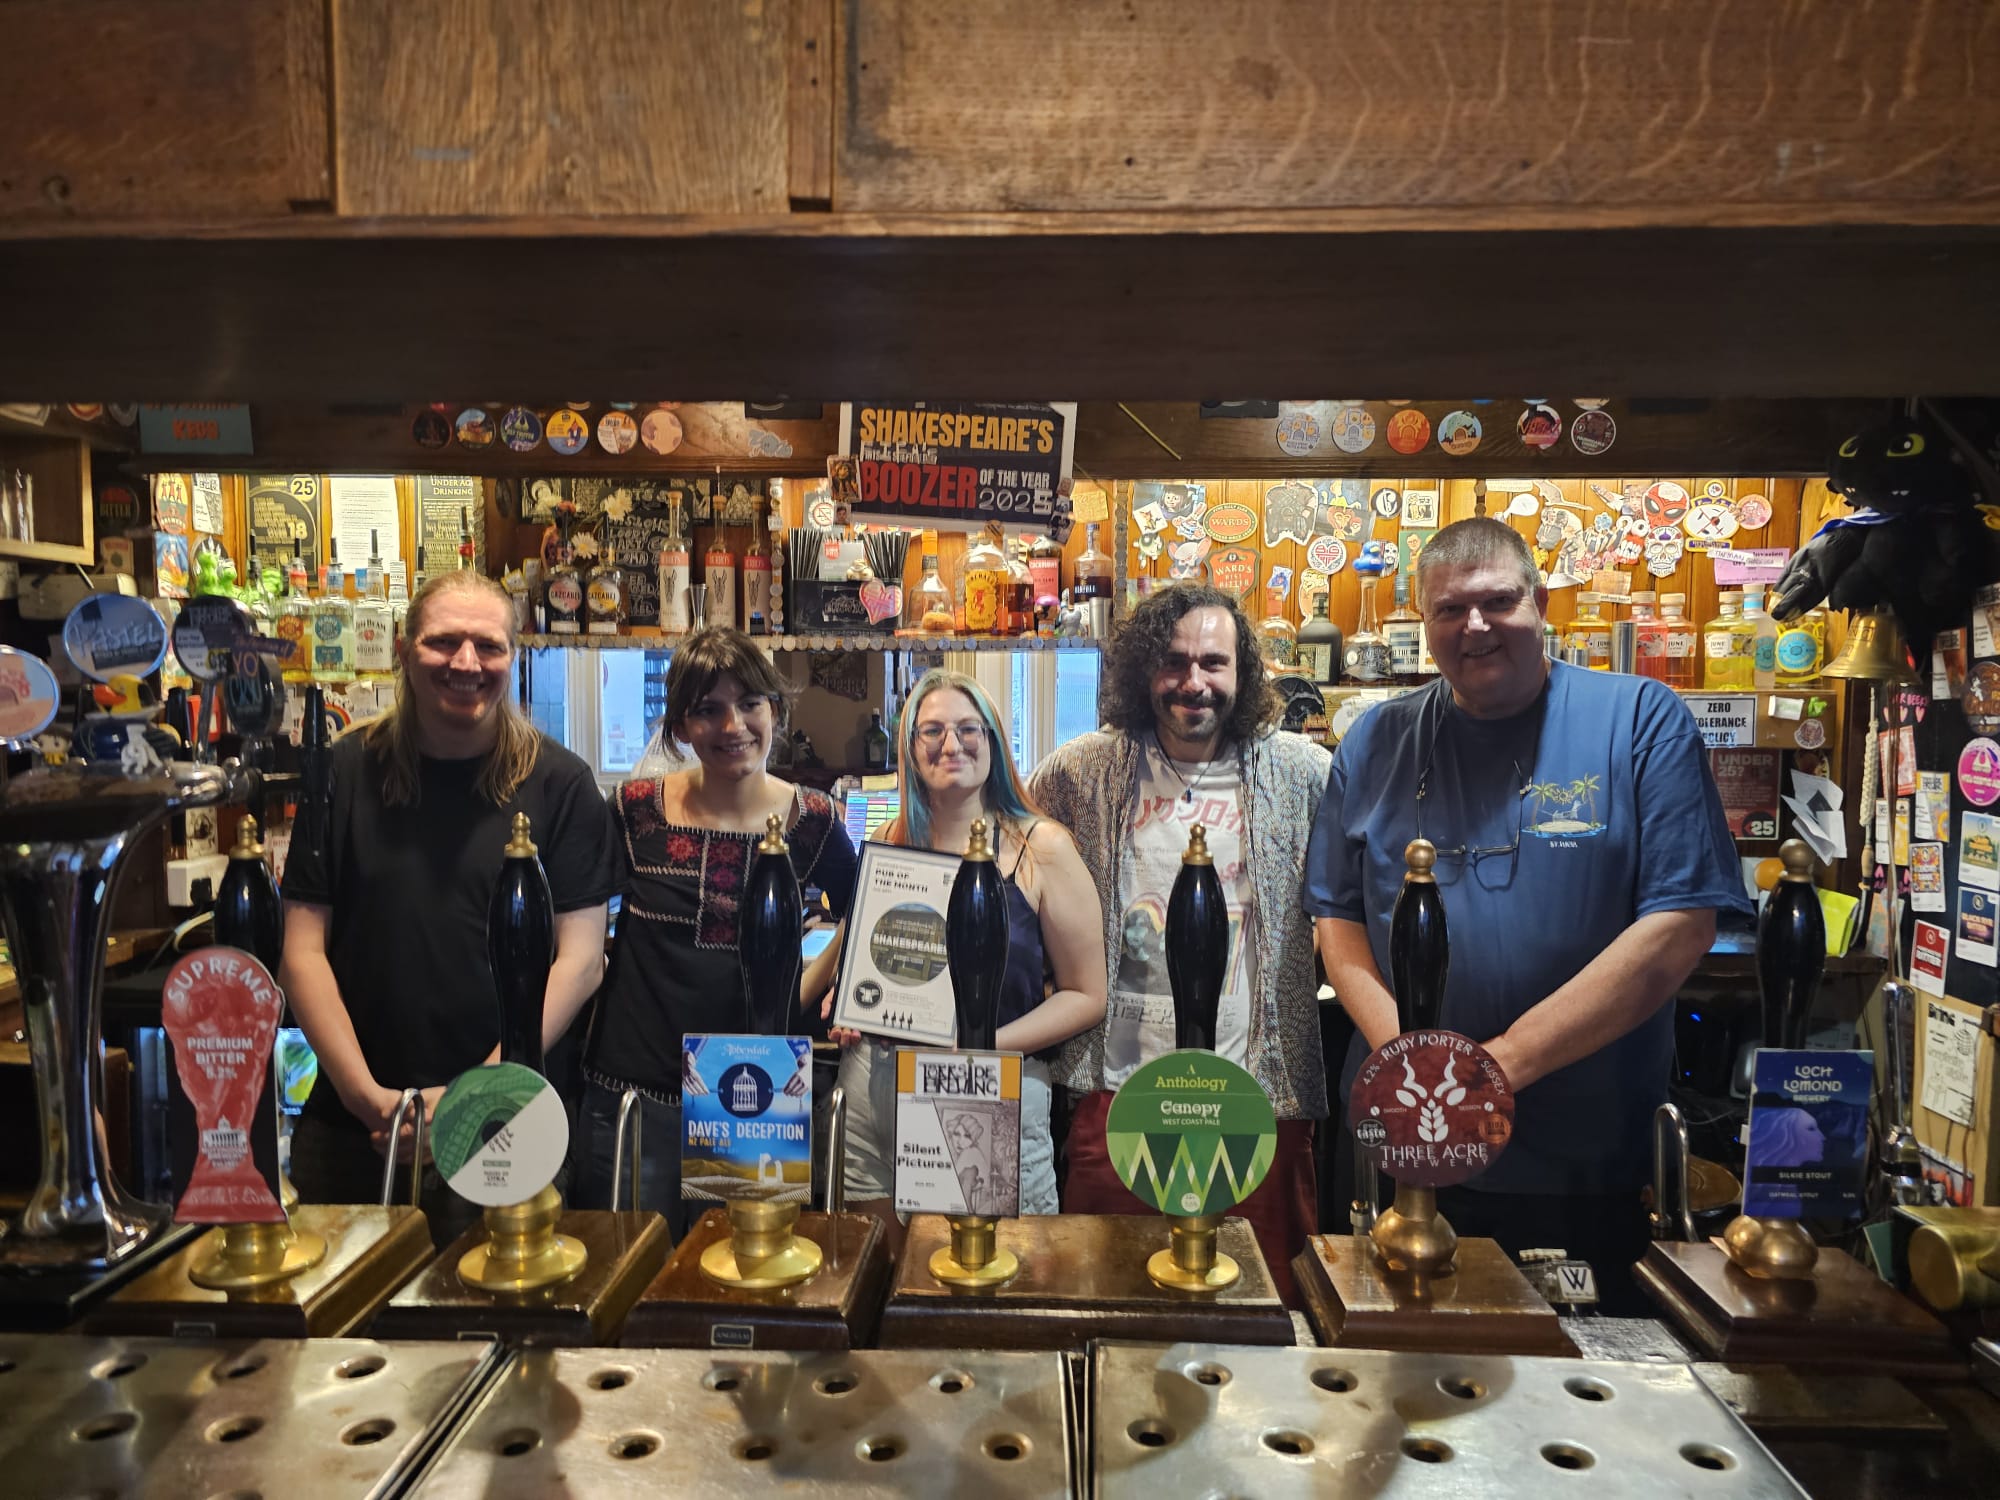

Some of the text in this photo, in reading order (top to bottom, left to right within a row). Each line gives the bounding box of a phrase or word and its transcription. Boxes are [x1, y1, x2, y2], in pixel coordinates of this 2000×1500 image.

[860, 408, 1054, 453] SHAKESPEARE'S
[293, 480, 314, 496] 25
[860, 461, 1050, 509] BOOZER OF THE YEAR
[1211, 518, 1249, 526] WARDS
[1215, 564, 1252, 577] WARD'S
[1707, 702, 1731, 713] ZERO
[1695, 716, 1747, 728] TOLERANCE
[1702, 730, 1736, 743] POLICY
[1718, 754, 1774, 766] UNDER
[1717, 766, 1744, 777] 25?
[1751, 820, 1774, 836] 25
[875, 869, 895, 878] PUB
[874, 879, 928, 893] THE MONTH
[167, 956, 272, 1004] SUPREME
[187, 1037, 253, 1050] PREMIUM
[1381, 1033, 1473, 1061] RUBY PORTER
[195, 1052, 246, 1065] BITTER
[1480, 1060, 1506, 1096] SUSSEX
[1795, 1065, 1833, 1079] LOCH
[1154, 1076, 1228, 1091] Anthology
[1783, 1080, 1842, 1092] LOMOND
[1160, 1100, 1222, 1118] Canopy
[1162, 1118, 1220, 1126] WEST COAST PALE
[688, 1119, 804, 1141] DAVE'S DECEPTION
[1356, 1128, 1386, 1140] taste
[699, 1137, 716, 1146] PALE
[903, 1142, 941, 1155] Silent
[1379, 1143, 1488, 1161] THREE ACRE
[897, 1157, 952, 1169] Pictures
[1382, 1158, 1489, 1169] BREWERY
[1561, 1268, 1587, 1291] W
